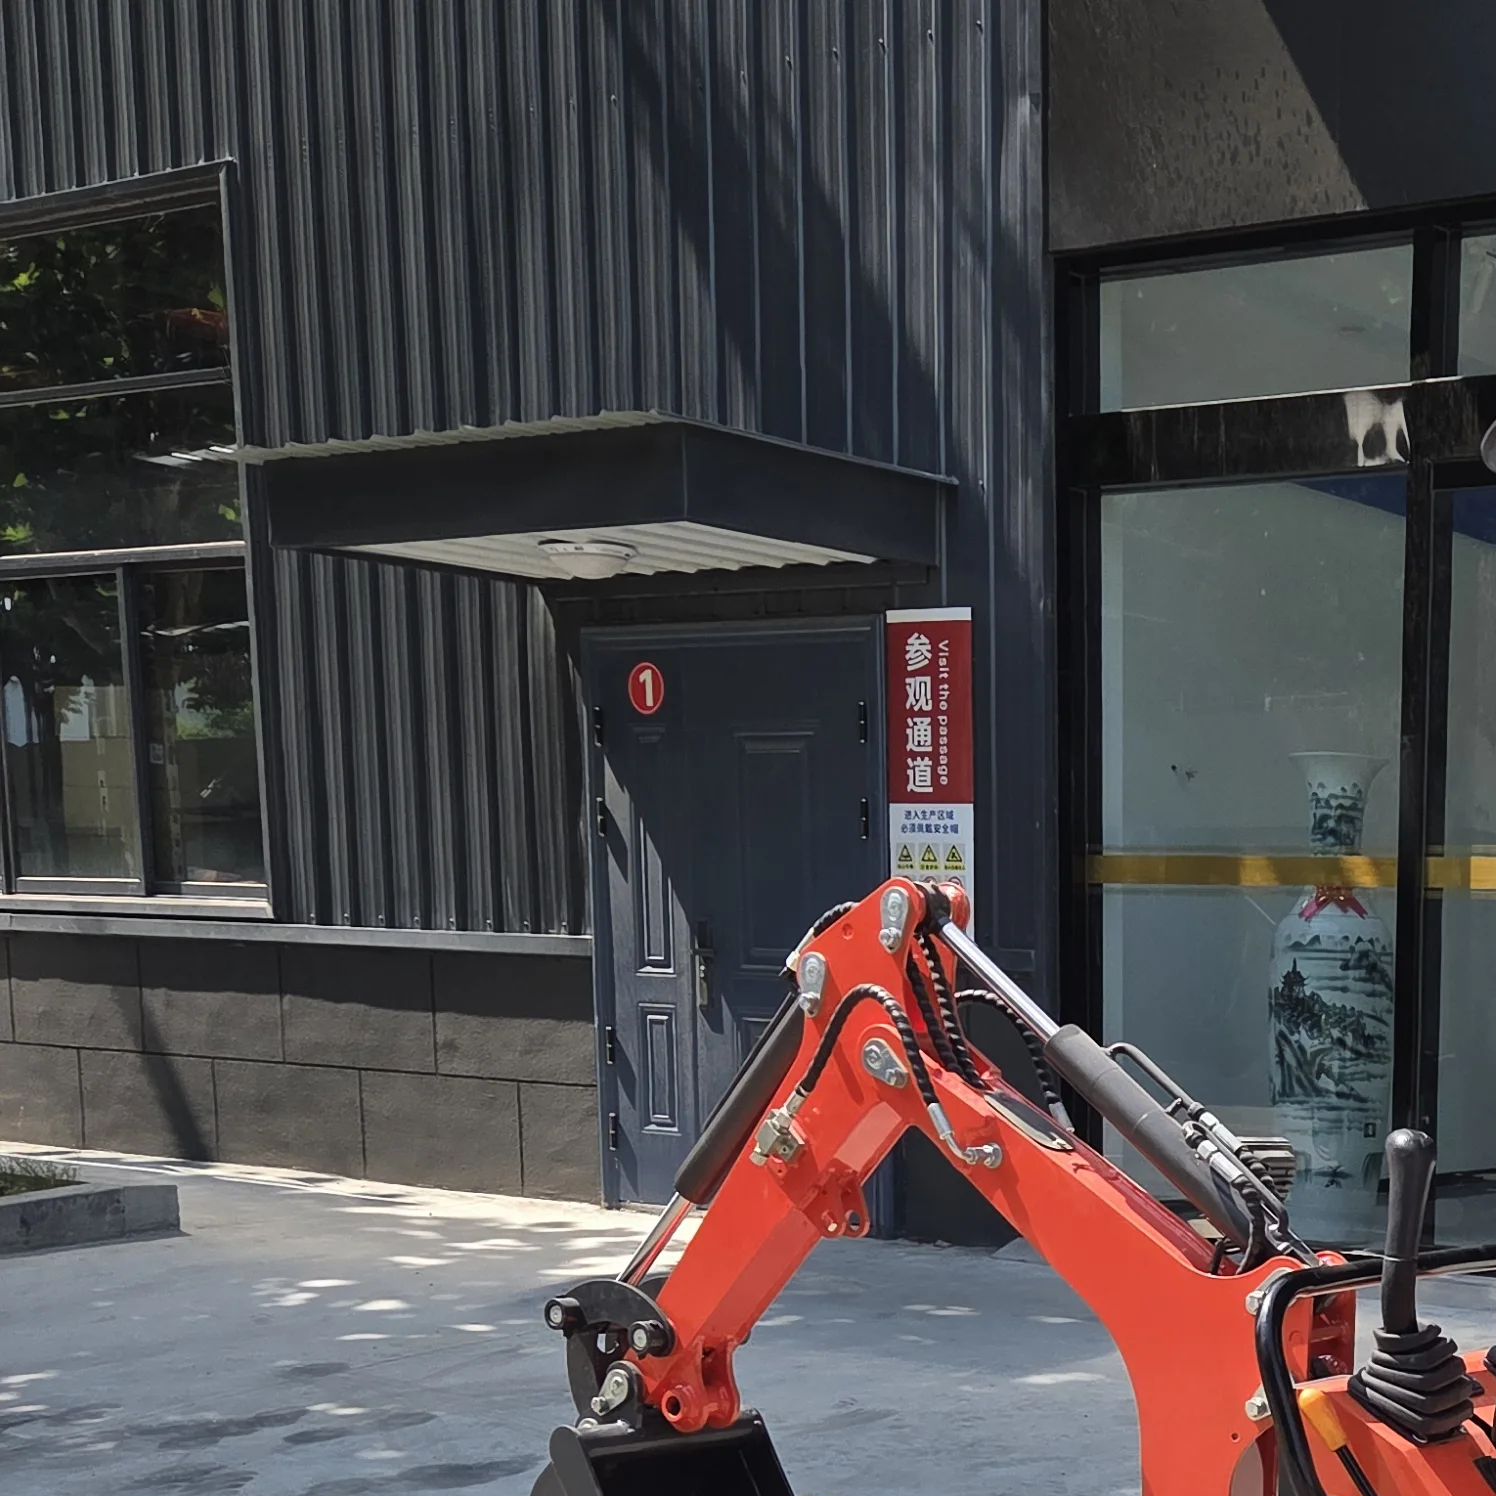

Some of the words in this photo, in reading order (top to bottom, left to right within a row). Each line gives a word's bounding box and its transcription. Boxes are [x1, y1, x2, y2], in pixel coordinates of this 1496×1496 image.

[938, 640, 950, 679] Visit
[638, 669, 654, 707] 1
[938, 684, 950, 710] the
[905, 632, 934, 792] 参观通道
[937, 716, 948, 785] passage
[904, 810, 954, 820] 进入生产区域
